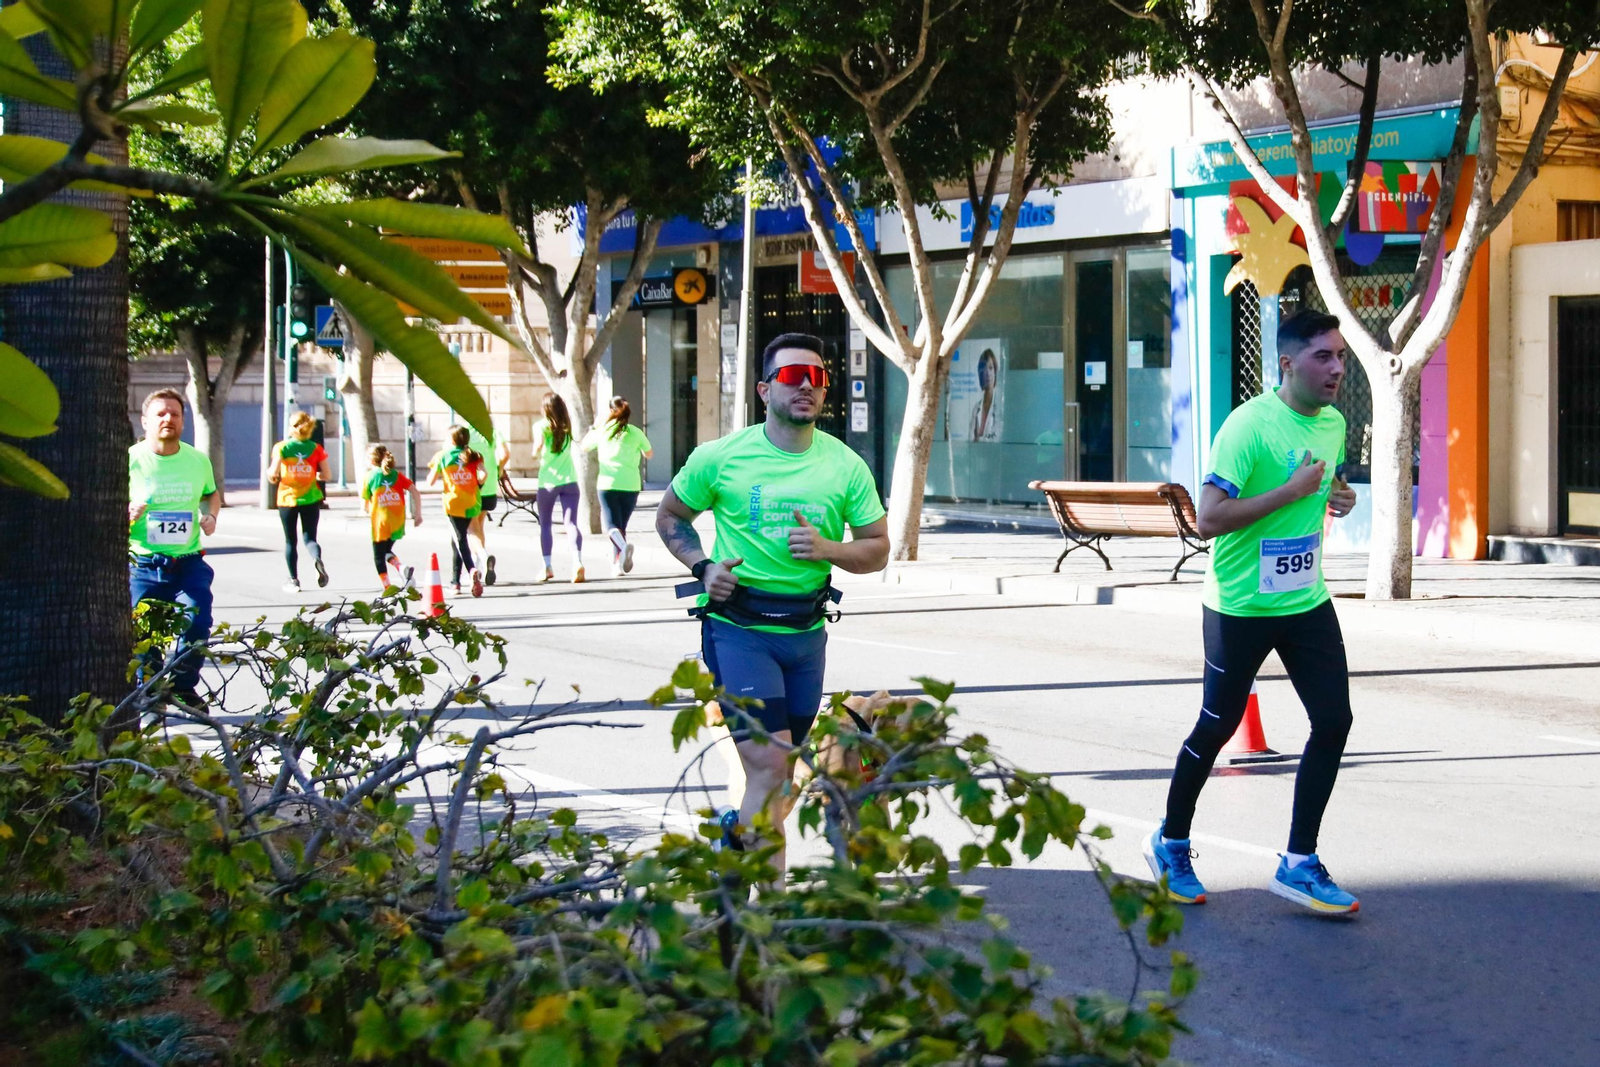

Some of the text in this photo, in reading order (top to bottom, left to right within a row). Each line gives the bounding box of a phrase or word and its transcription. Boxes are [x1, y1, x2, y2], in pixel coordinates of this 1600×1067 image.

[622, 214, 631, 228] tu
[460, 272, 505, 280] Americano
[641, 283, 674, 301] CaixaBan
[1287, 449, 1297, 479] ERÍA
[748, 484, 761, 535] ALMERÍA
[762, 499, 827, 514] En marcha
[762, 510, 824, 525] cont el
[158, 522, 187, 534] 124
[1275, 552, 1314, 575] 599
